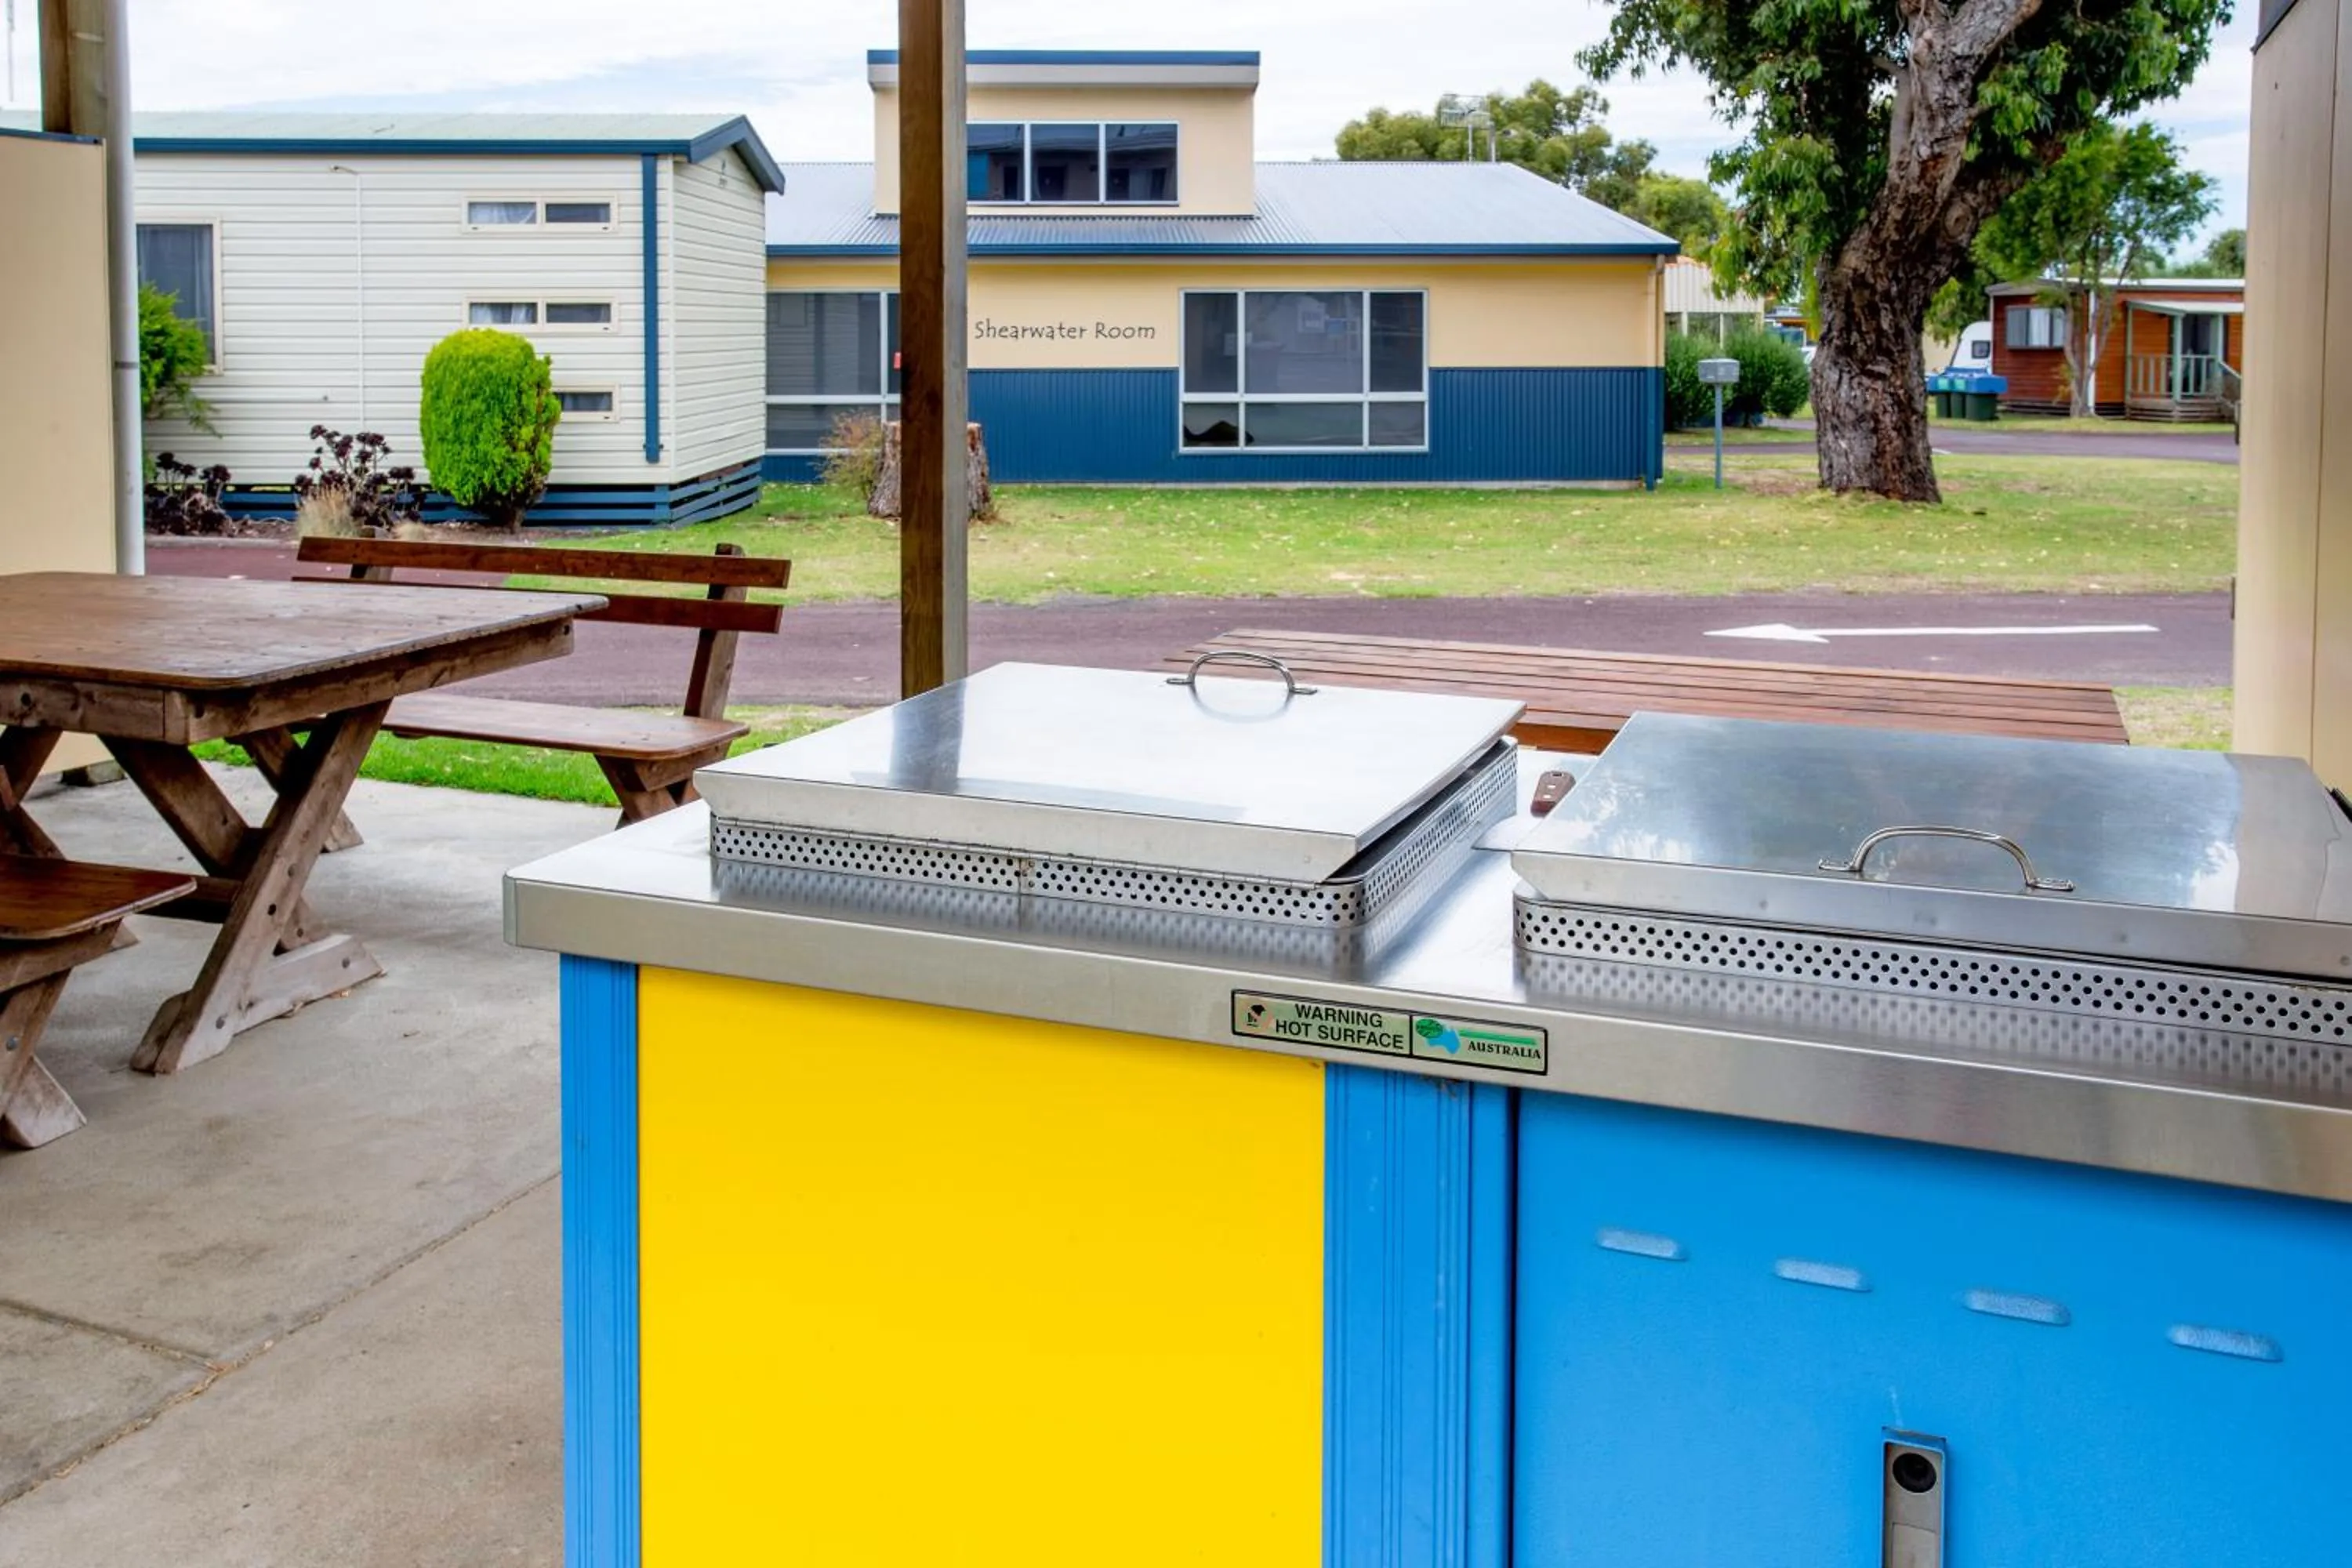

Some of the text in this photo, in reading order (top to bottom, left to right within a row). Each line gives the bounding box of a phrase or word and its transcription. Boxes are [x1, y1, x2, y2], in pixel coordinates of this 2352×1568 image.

[975, 318, 1156, 339] Shearwater Room
[1294, 1003, 1382, 1028] WARNING
[1276, 1019, 1404, 1049] HOT SURFACE
[1467, 1040, 1541, 1059] AUSTRALIA
